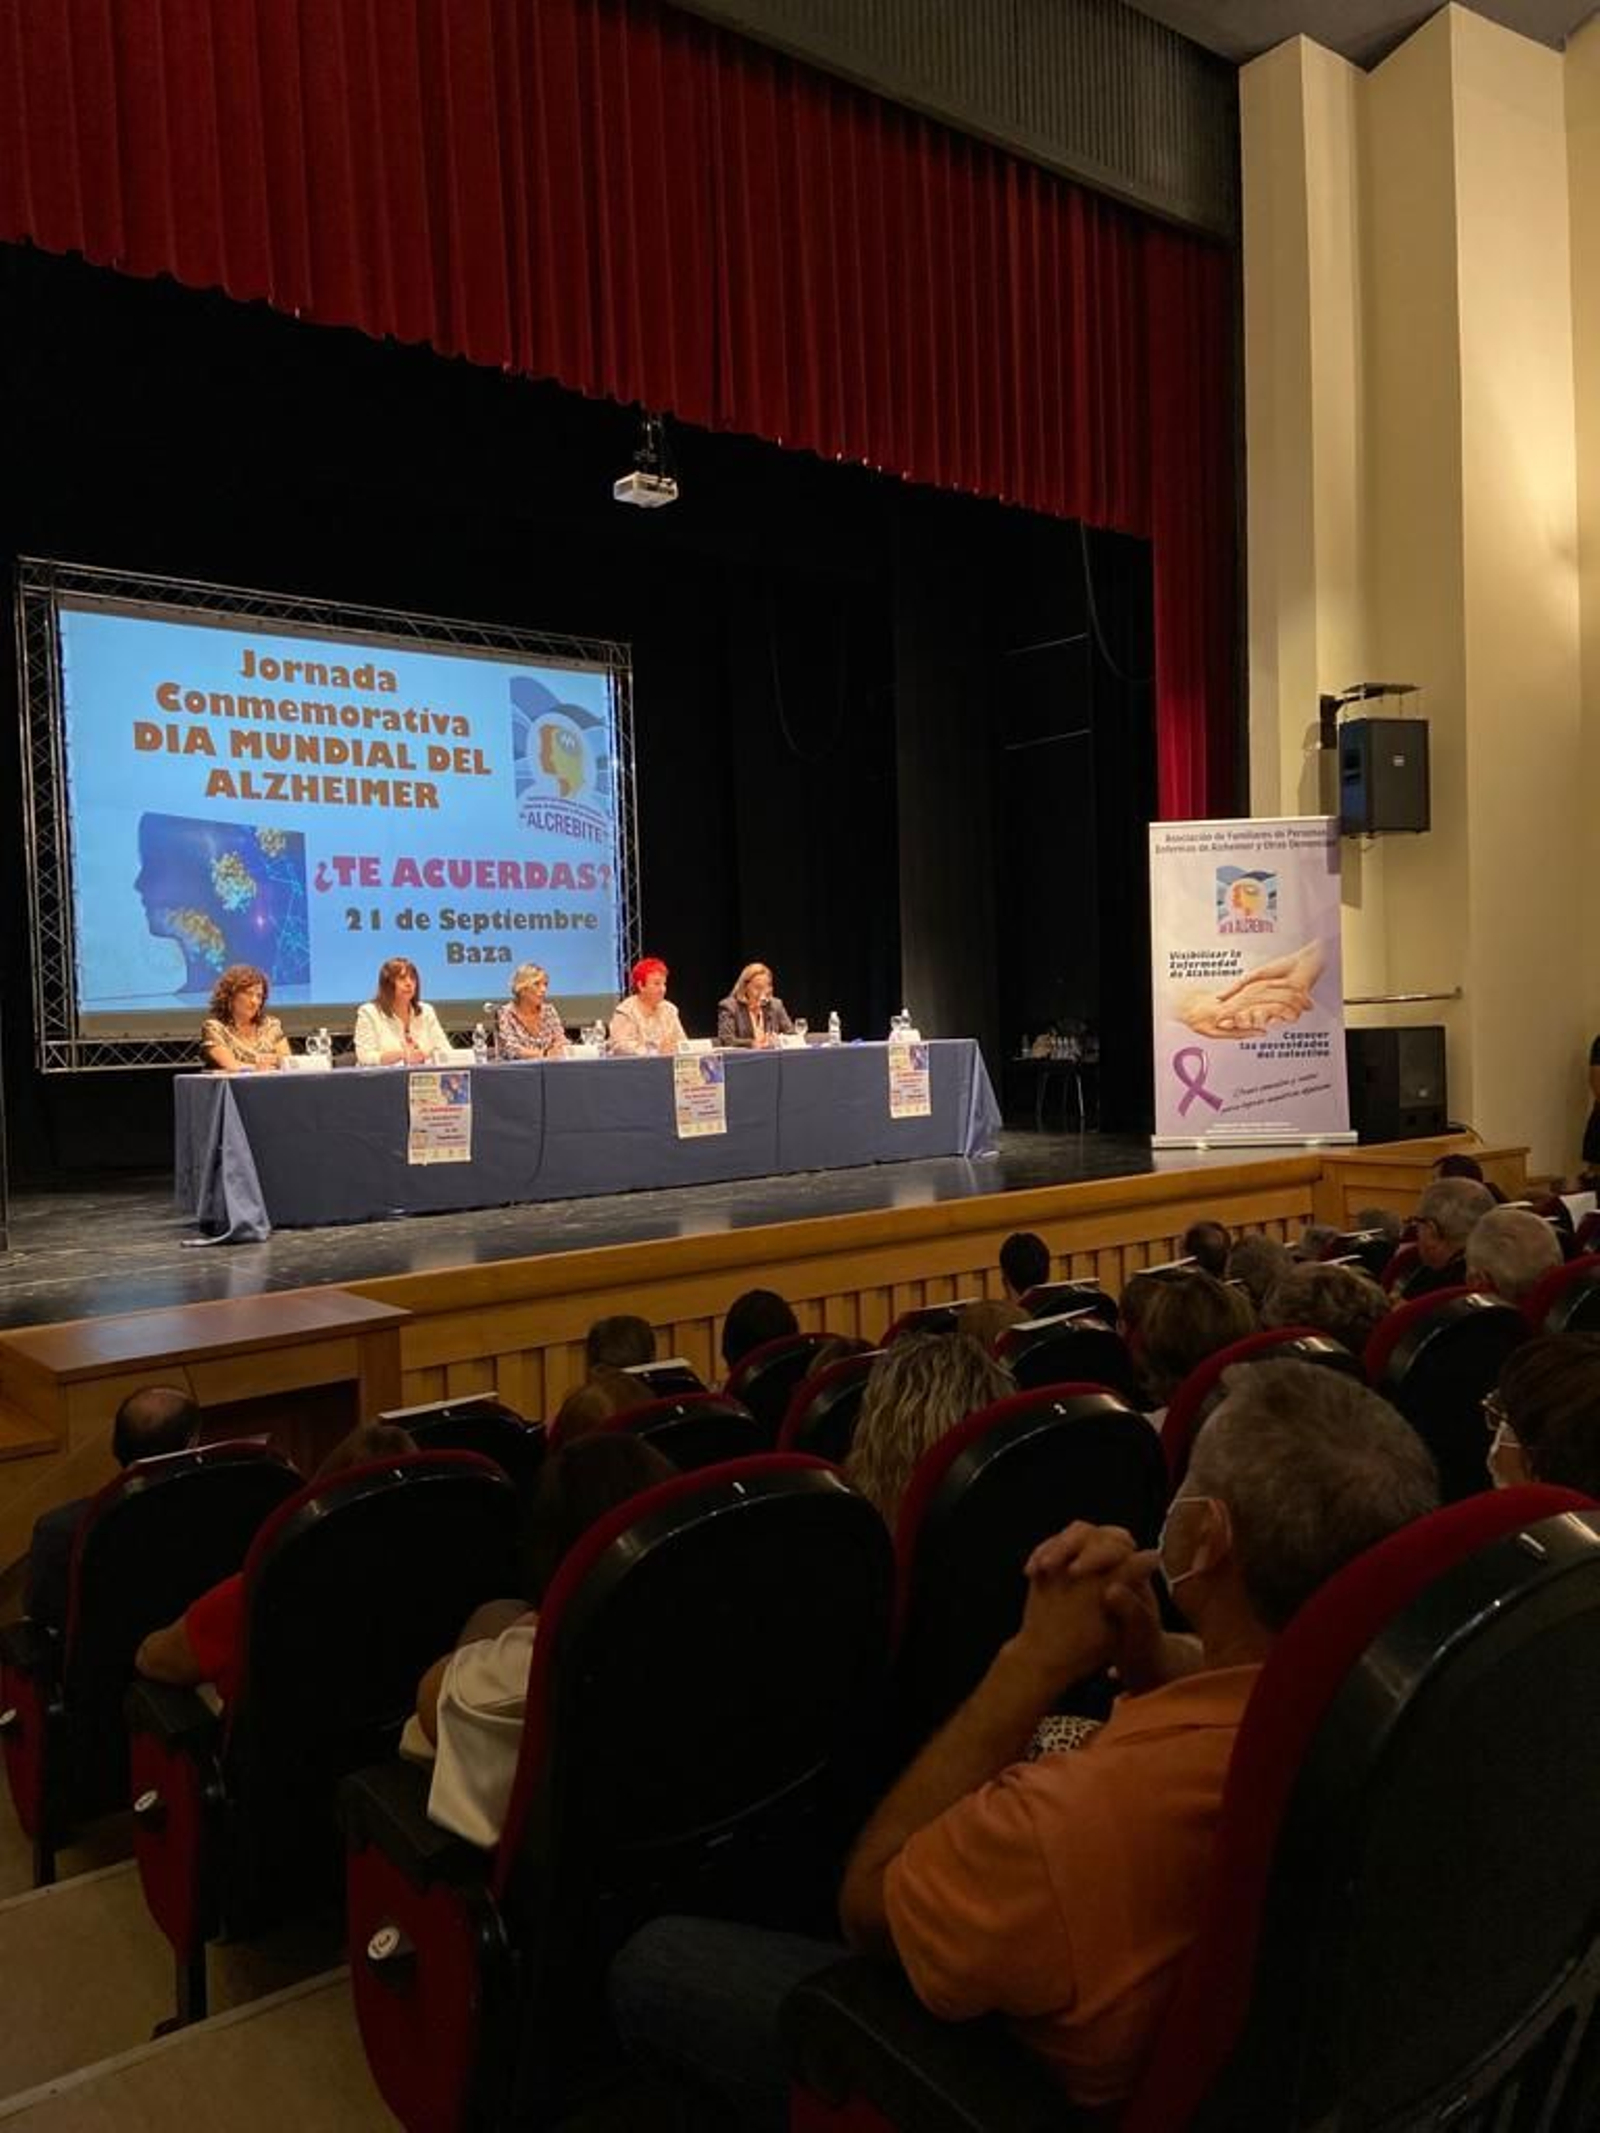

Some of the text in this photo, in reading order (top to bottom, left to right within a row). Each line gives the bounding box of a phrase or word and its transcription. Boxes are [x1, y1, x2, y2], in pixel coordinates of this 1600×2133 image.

[239, 649, 396, 692] Jornada
[155, 682, 470, 736] Conmemorativa
[133, 722, 491, 774] DIA MUNDIAL DEL
[206, 769, 439, 809] ALZHEIMER
[314, 856, 612, 892] ¿TE ACUERDAS?
[345, 908, 599, 934] 21 de Septiembre
[446, 942, 513, 964] Baza
[1169, 959, 1238, 970] Enfermedad
[1169, 970, 1183, 978] de
